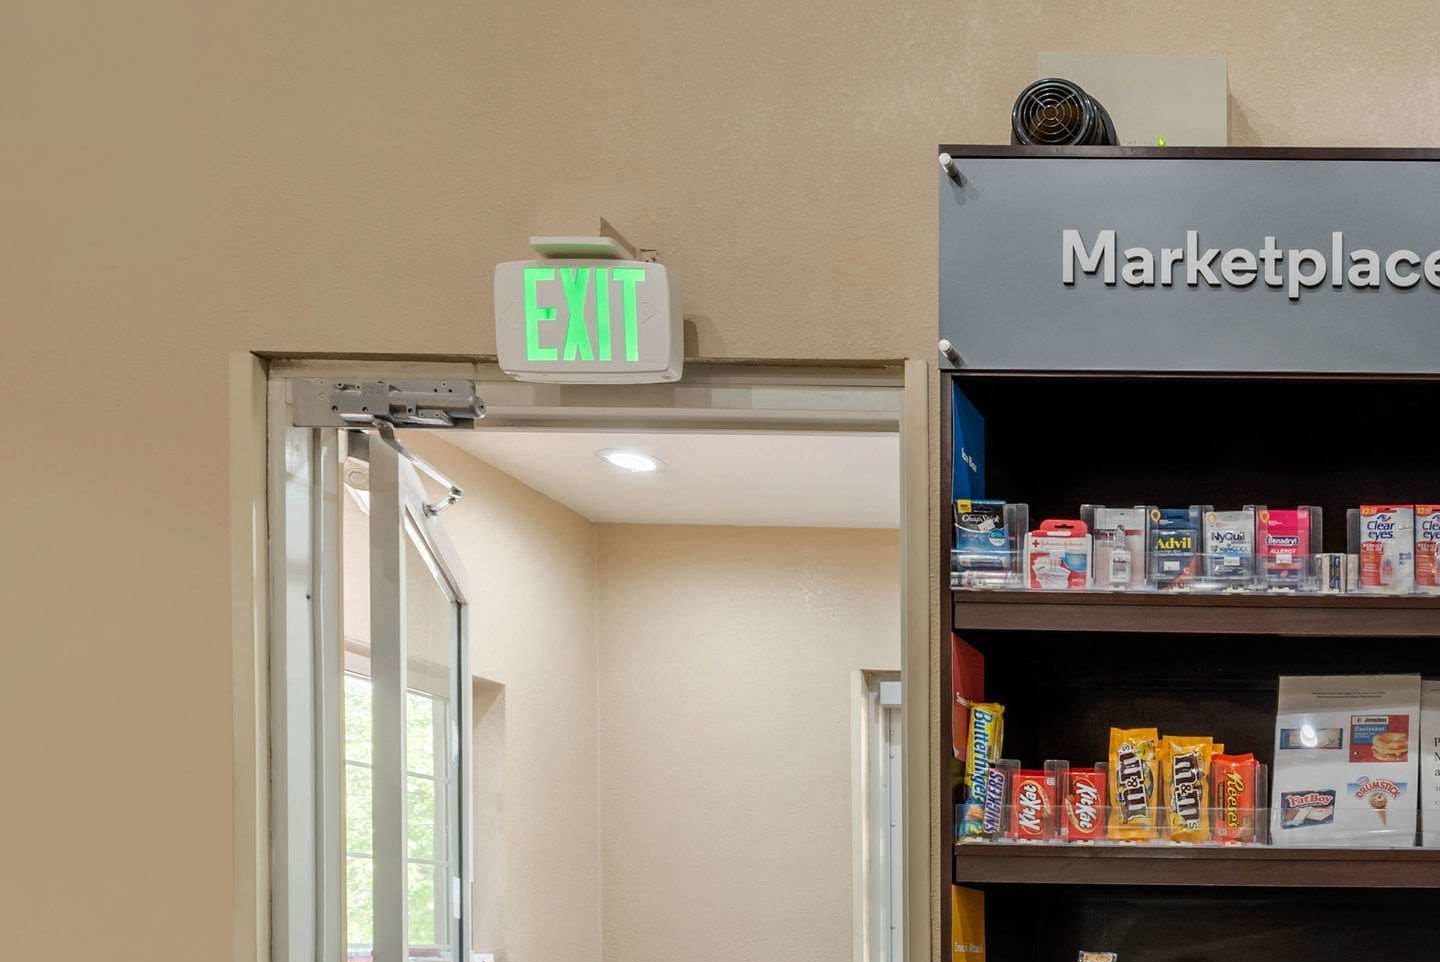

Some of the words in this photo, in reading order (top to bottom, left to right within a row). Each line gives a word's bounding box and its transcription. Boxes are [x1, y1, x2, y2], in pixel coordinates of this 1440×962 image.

[523, 267, 646, 363] EXIT
[1367, 520, 1394, 531] Clear
[1368, 530, 1393, 541] eyes
[1155, 535, 1193, 549] Advil
